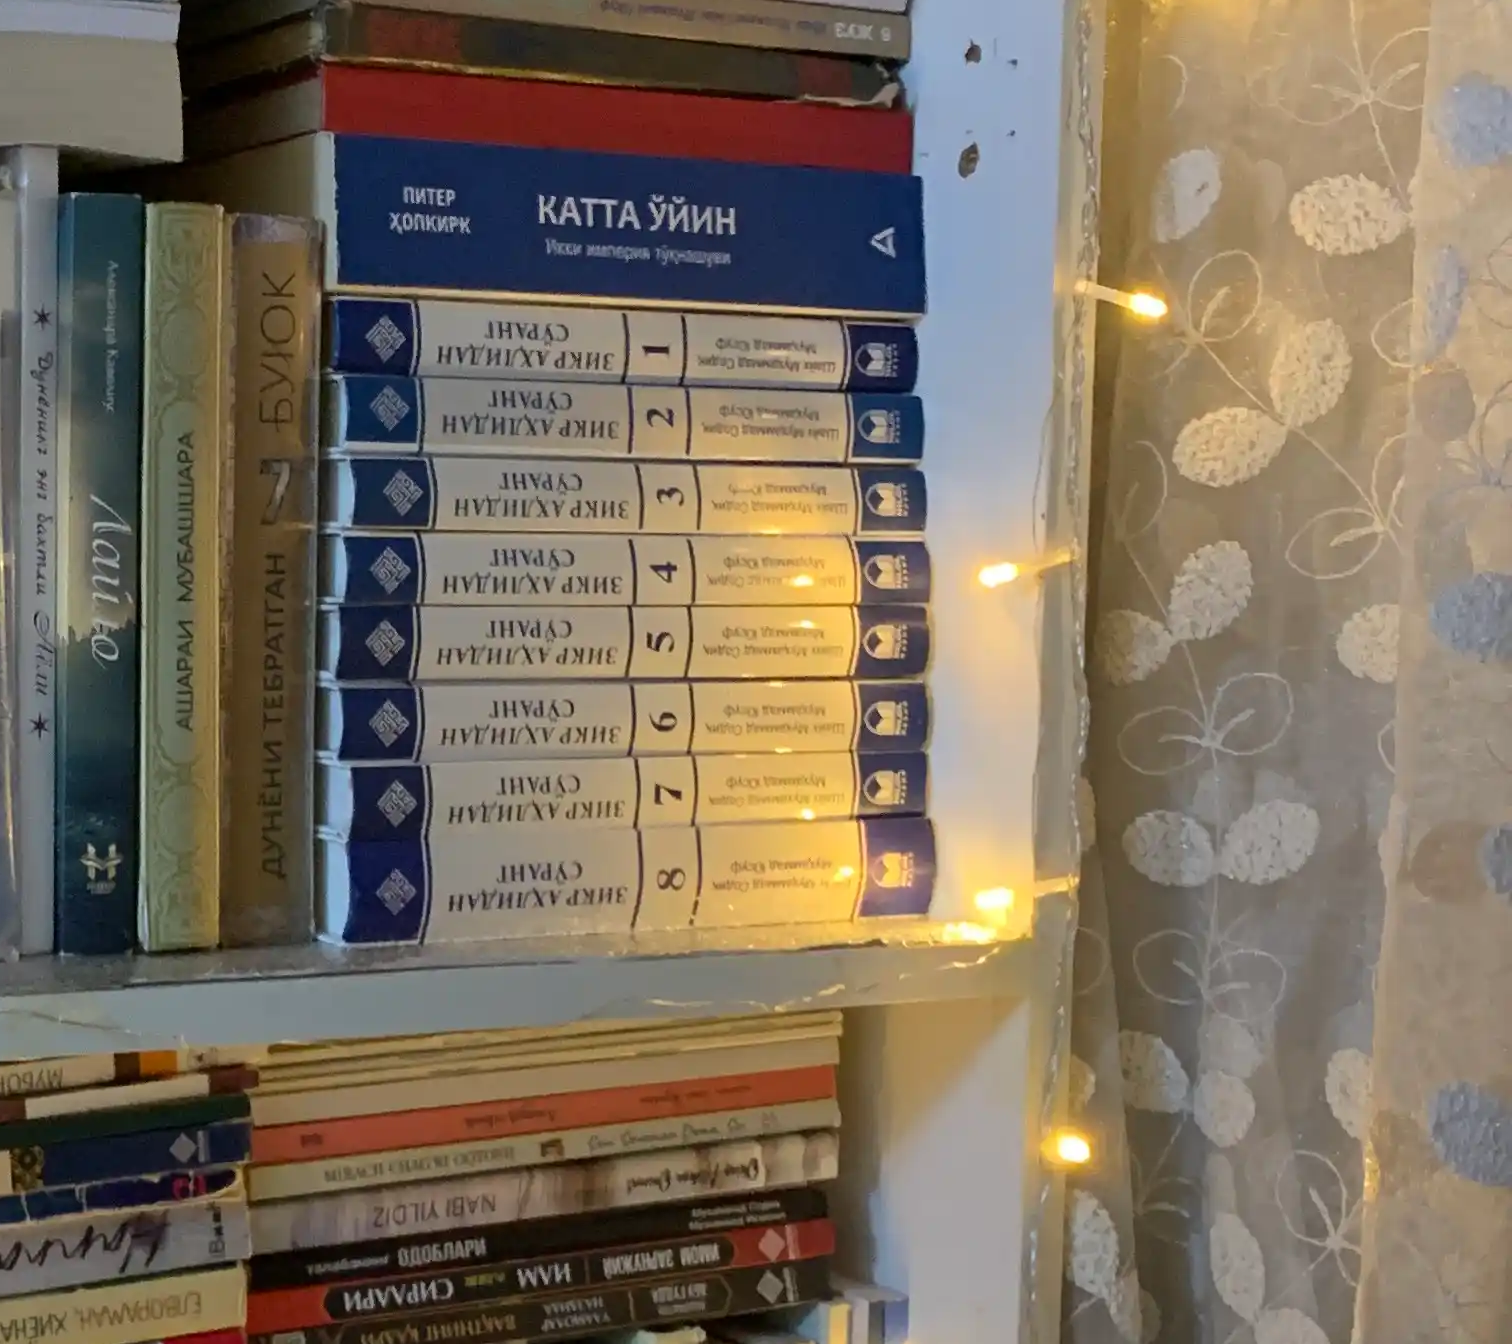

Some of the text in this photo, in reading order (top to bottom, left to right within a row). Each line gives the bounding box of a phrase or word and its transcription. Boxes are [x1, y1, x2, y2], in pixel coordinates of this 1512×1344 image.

[403, 186, 736, 235] ПИТЕР КАТТА ЎЙИН
[484, 321, 569, 346] СЎРАНГ
[436, 344, 670, 370] ЗИКР АҲЛИДАН 1
[487, 389, 573, 415] СЎРАНГ
[441, 408, 675, 439] ЗИКР АҲЛИДАН 2
[36, 468, 48, 501] энг
[498, 472, 583, 495] СЎРАНГ
[453, 487, 685, 519] ЗИКР АҲЛИДАН 3
[256, 270, 296, 879] ДУНЁНИ ТЕБРАТГАН БУЮК
[489, 548, 576, 571] СЎРАНГ
[174, 430, 195, 732] АШАРАИ МУБАШШАРА
[443, 561, 678, 595] ЗИКР АҲЛИДАН 4
[485, 619, 573, 644] СЎРАНГ
[436, 631, 676, 666] ЗИКР АҲЛИДАН 5
[488, 699, 575, 723] СЎРАНГ
[438, 712, 678, 746] ЗИКР АҲЛИДАН 6
[496, 773, 581, 799] СЎРАНГ
[448, 782, 683, 825] ЗИКР АҲЛИДАН 7
[496, 860, 583, 886] СЎРАНГ
[448, 868, 686, 913] ЗИКР АҲЛИДАН 8
[372, 1192, 497, 1229] NABI YILDIZ
[343, 1262, 573, 1312] ИЛМ СИРЛАРИ
